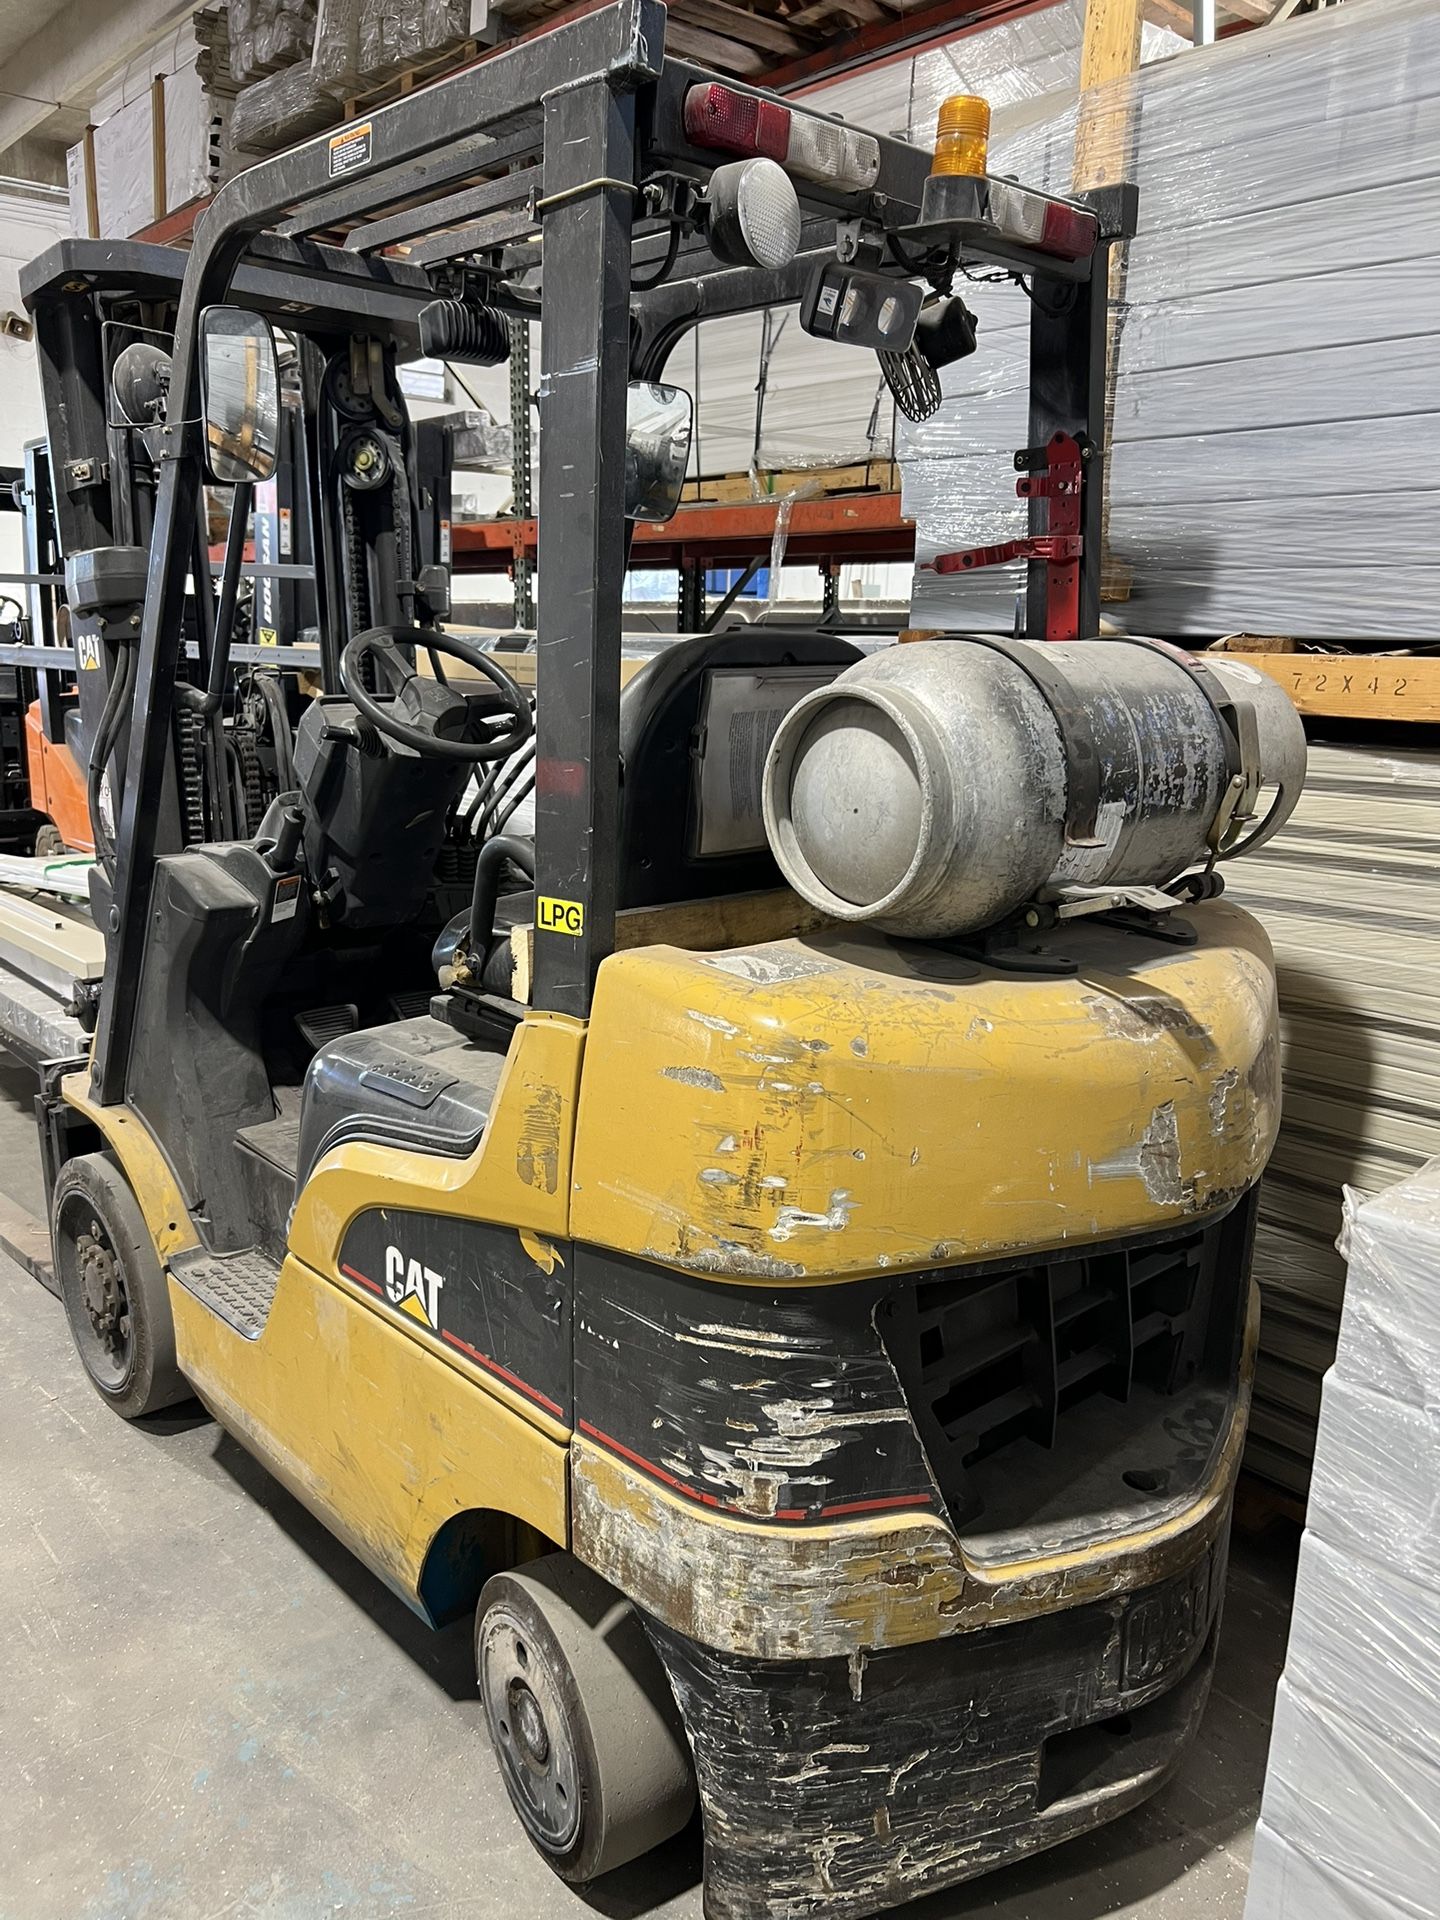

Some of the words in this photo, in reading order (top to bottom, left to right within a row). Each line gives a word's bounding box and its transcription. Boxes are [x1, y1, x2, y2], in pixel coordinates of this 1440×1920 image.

[78, 634, 100, 670] CAT
[541, 901, 581, 931] LPG
[386, 1245, 444, 1330] CAT
